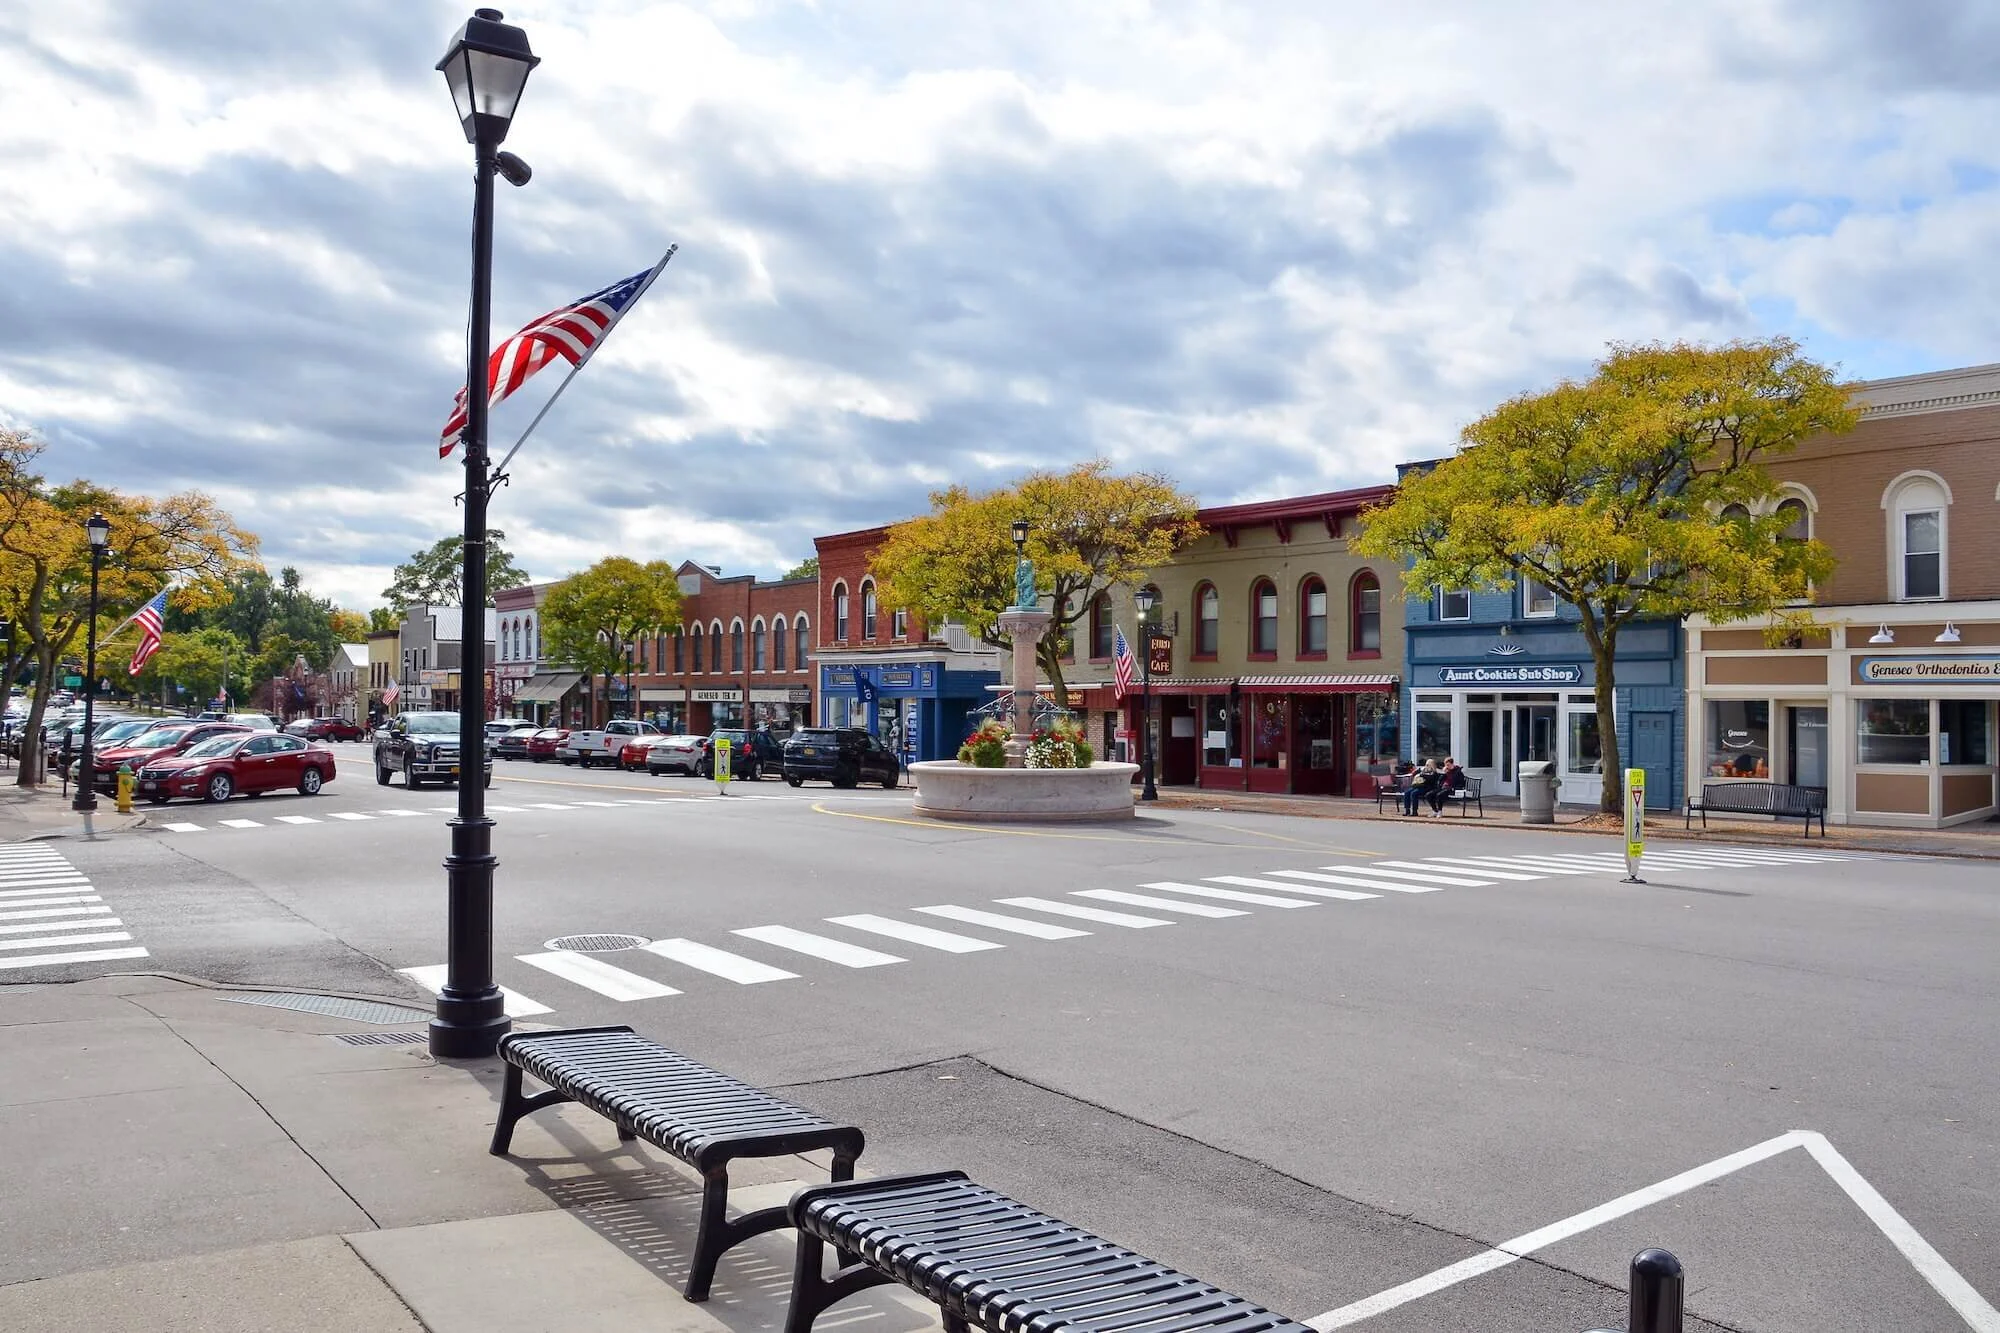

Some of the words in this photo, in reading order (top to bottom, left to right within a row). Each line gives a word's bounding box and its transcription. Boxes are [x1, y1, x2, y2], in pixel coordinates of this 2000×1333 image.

[1151, 638, 1171, 650] EURO
[1445, 669, 1474, 681] Aunt
[1474, 668, 1517, 681] Cookie's
[1518, 668, 1542, 681] Sub
[1542, 668, 1574, 681] Shop
[1871, 663, 1913, 678] Geneseo
[1915, 663, 1990, 675] Orthodontics
